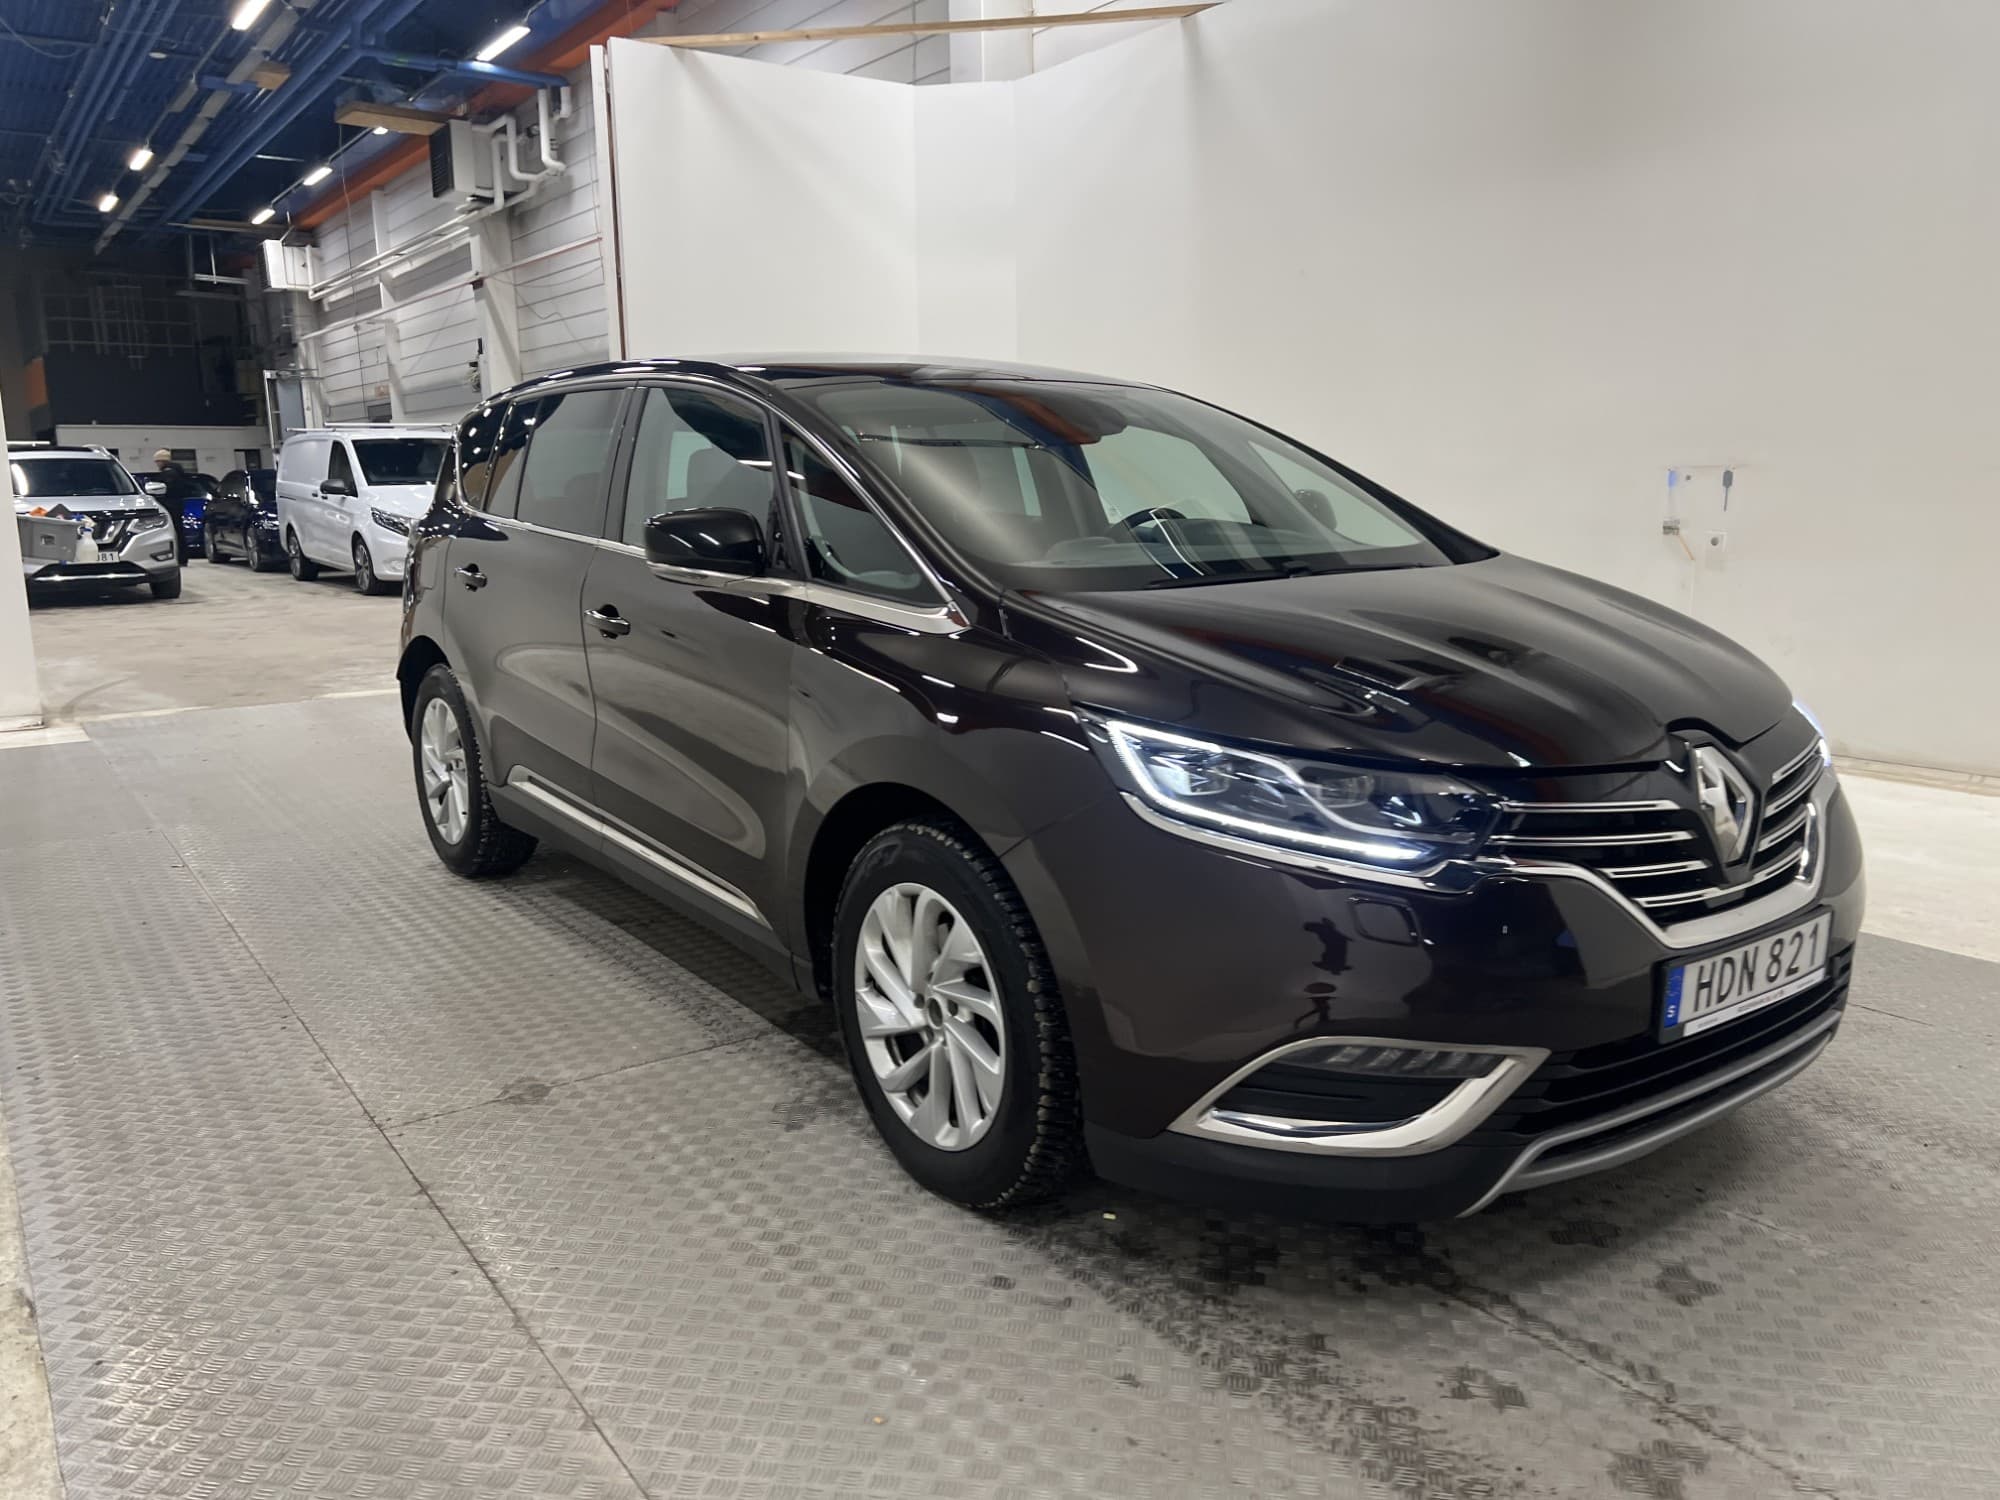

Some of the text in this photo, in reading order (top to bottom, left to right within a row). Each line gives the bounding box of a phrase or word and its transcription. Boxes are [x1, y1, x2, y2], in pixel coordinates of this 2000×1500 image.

[1694, 923, 1819, 1012] HDN 821
[1666, 1004, 1676, 1018] S
